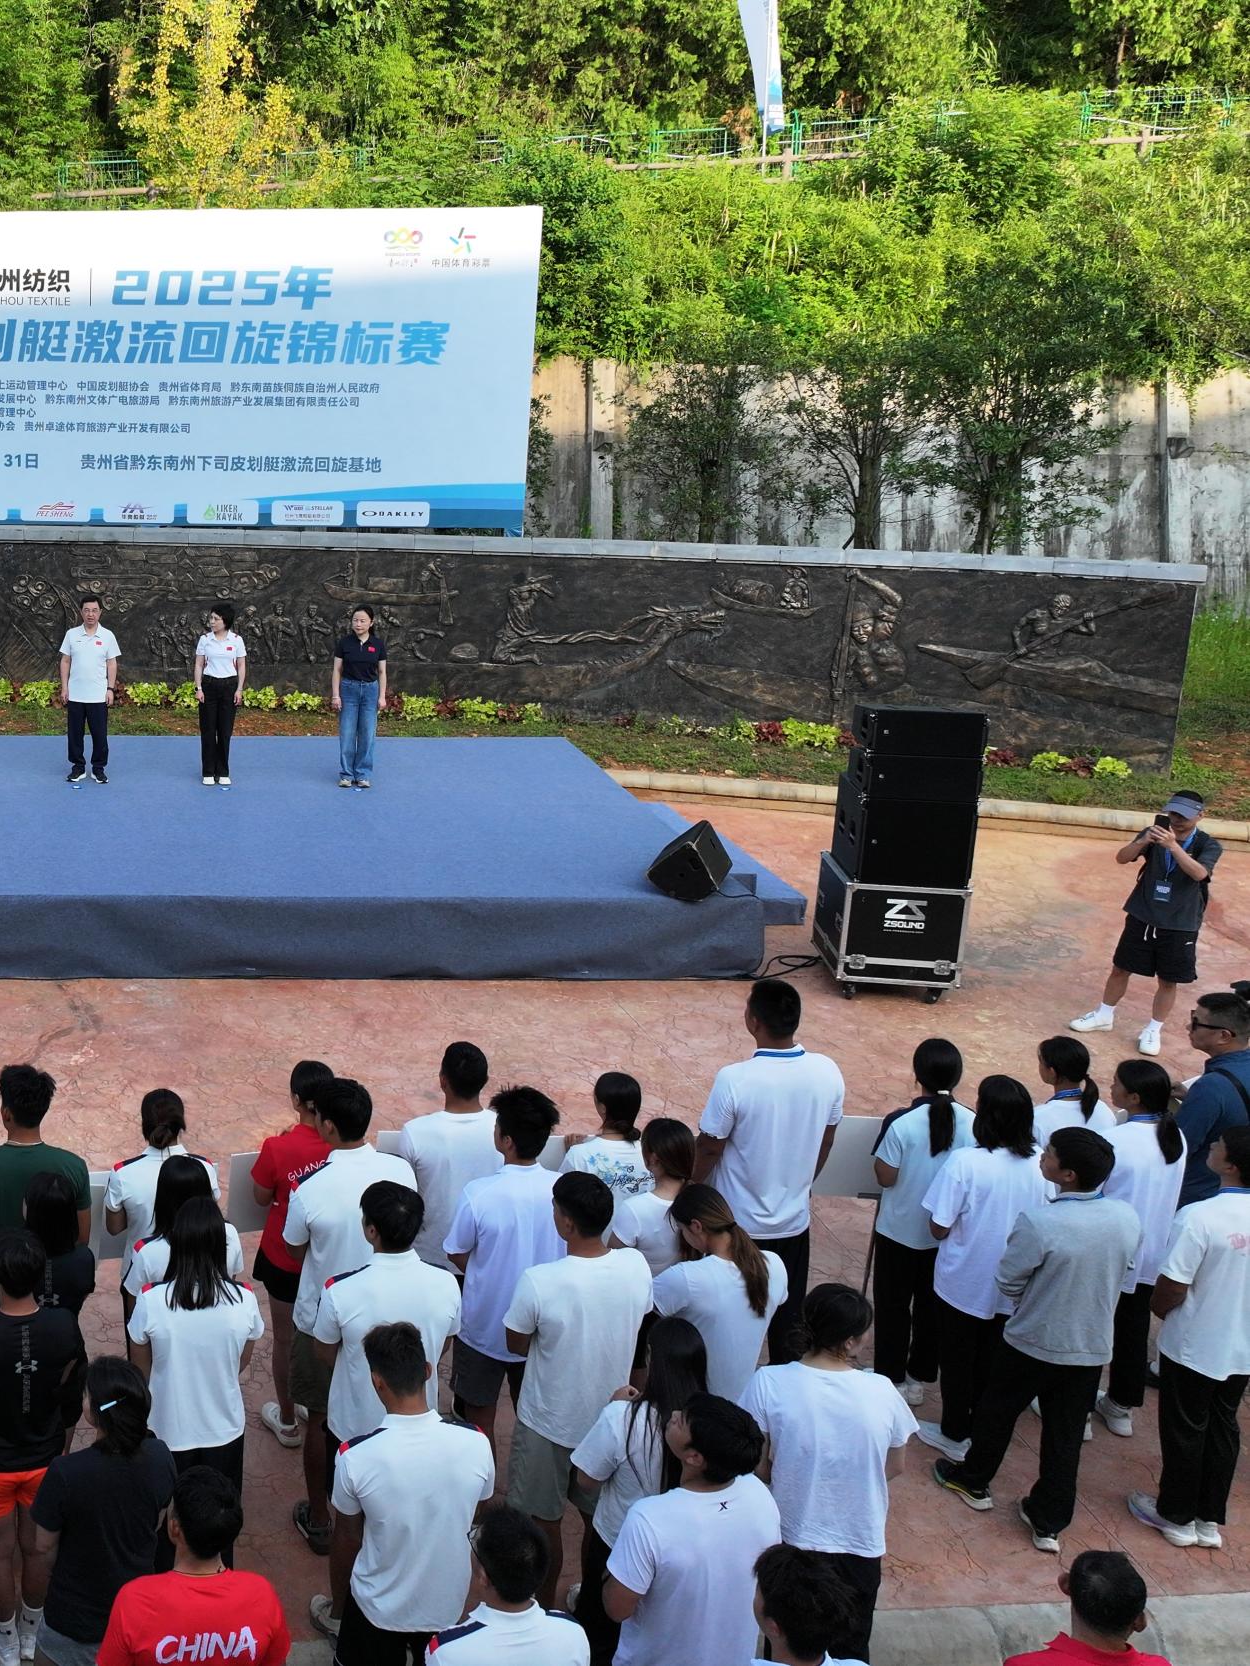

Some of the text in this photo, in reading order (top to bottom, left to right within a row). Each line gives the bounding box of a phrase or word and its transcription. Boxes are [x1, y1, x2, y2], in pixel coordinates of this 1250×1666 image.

[111, 265, 334, 310] 2025年
[28, 296, 71, 307] TEXTILE
[76, 380, 150, 392] 中国皮划艇协会
[158, 381, 222, 393] 贵州省体育局
[229, 382, 380, 394] 黔东南苗族侗族自治州人民政府
[44, 394, 160, 406] 黔东南州文体广电旅游局
[168, 395, 360, 408] 黔东南州旅游产业发展集团有限责任公司
[24, 421, 191, 434] 贵州卓途体育旅游产业开发有限公司
[80, 453, 382, 473] 贵州省黔东南州下司皮划艇激流回旋基地
[216, 512, 243, 521] KAYAK
[378, 506, 424, 517] OAKLEY
[883, 919, 925, 930] ZSOUND
[287, 1159, 328, 1182] GUANG
[155, 1625, 258, 1664] CHINA
